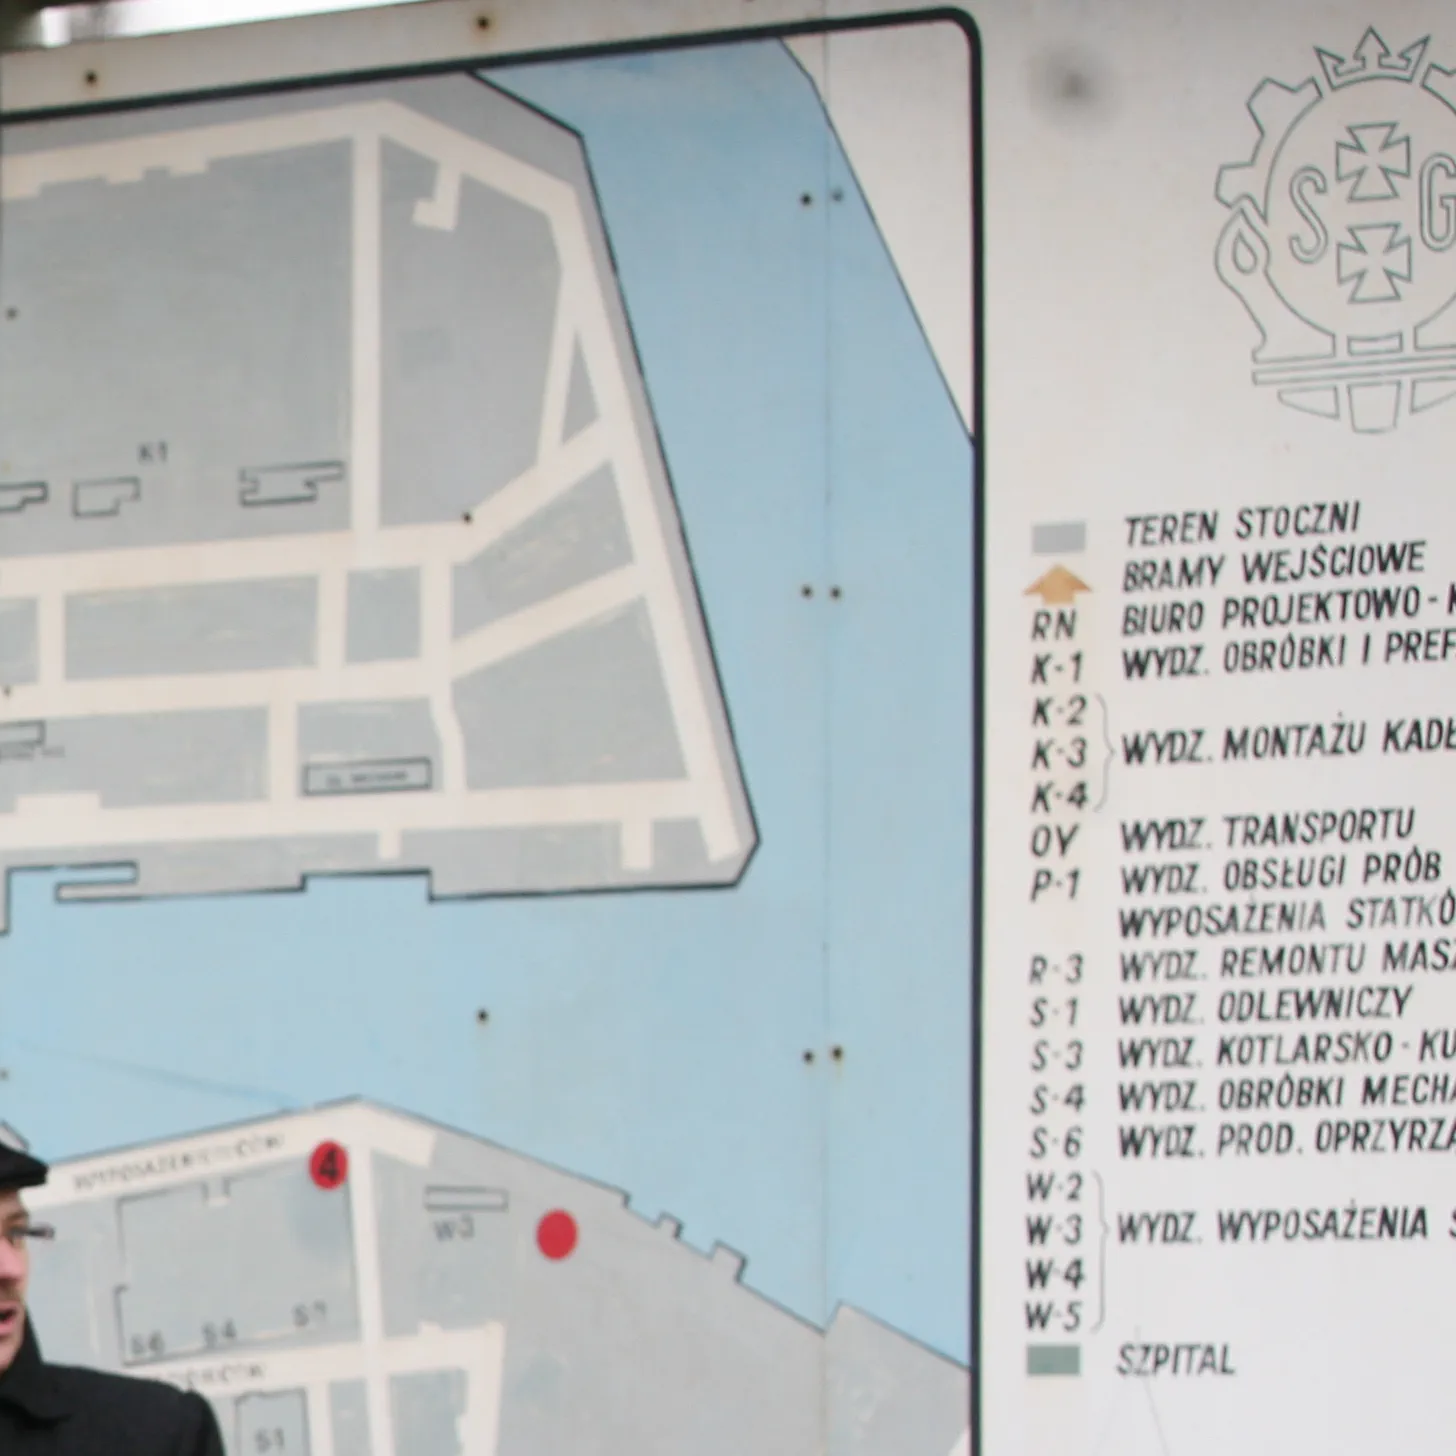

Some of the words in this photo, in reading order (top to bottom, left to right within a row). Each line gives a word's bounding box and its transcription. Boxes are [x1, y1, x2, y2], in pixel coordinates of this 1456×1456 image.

[1124, 509, 1219, 547] TEREN
[1235, 498, 1361, 541] STOCZNI
[1122, 552, 1226, 593] BRAMY
[1241, 538, 1427, 585] WEJŚCIOWE
[1030, 608, 1076, 641] RN
[1122, 599, 1205, 638] BIURO
[1220, 585, 1421, 630] PROJEKTOWO
[1122, 643, 1210, 681] WYDZ.
[1223, 631, 1346, 674] OBRÓBKI
[1361, 631, 1371, 666] I
[1121, 727, 1213, 766] WYDZ.
[1222, 710, 1367, 763] MONTAŻU
[1120, 815, 1212, 852] WYDZ.
[1222, 806, 1416, 849] TRANSPORTU
[1120, 861, 1208, 896] WYDZ.
[1223, 854, 1346, 892] OBSŁUGI
[1362, 845, 1442, 885] PRÓB
[1118, 893, 1327, 940] WYPOSAŻENIA
[1120, 948, 1208, 983] WYDZ.
[1220, 942, 1367, 979] REMONTU
[1382, 938, 1456, 975] MAS
[1118, 991, 1205, 1026] WYDZ.
[1217, 983, 1414, 1024] ODLEWNICZY
[1118, 1035, 1203, 1070] WYDZ.
[1216, 1029, 1394, 1068] KOTLARSKO
[1118, 1078, 1207, 1113] WYDZ.
[1217, 1070, 1345, 1111] OBRÓBKI
[1118, 1122, 1206, 1159] WYDZ.
[1217, 1120, 1305, 1157] PROD.
[318, 1146, 341, 1182] 4
[1117, 1210, 1203, 1246] WYDZ.
[1216, 1197, 1429, 1243] WYPOSAŻENIA
[1115, 1340, 1237, 1378] SZPITAL
